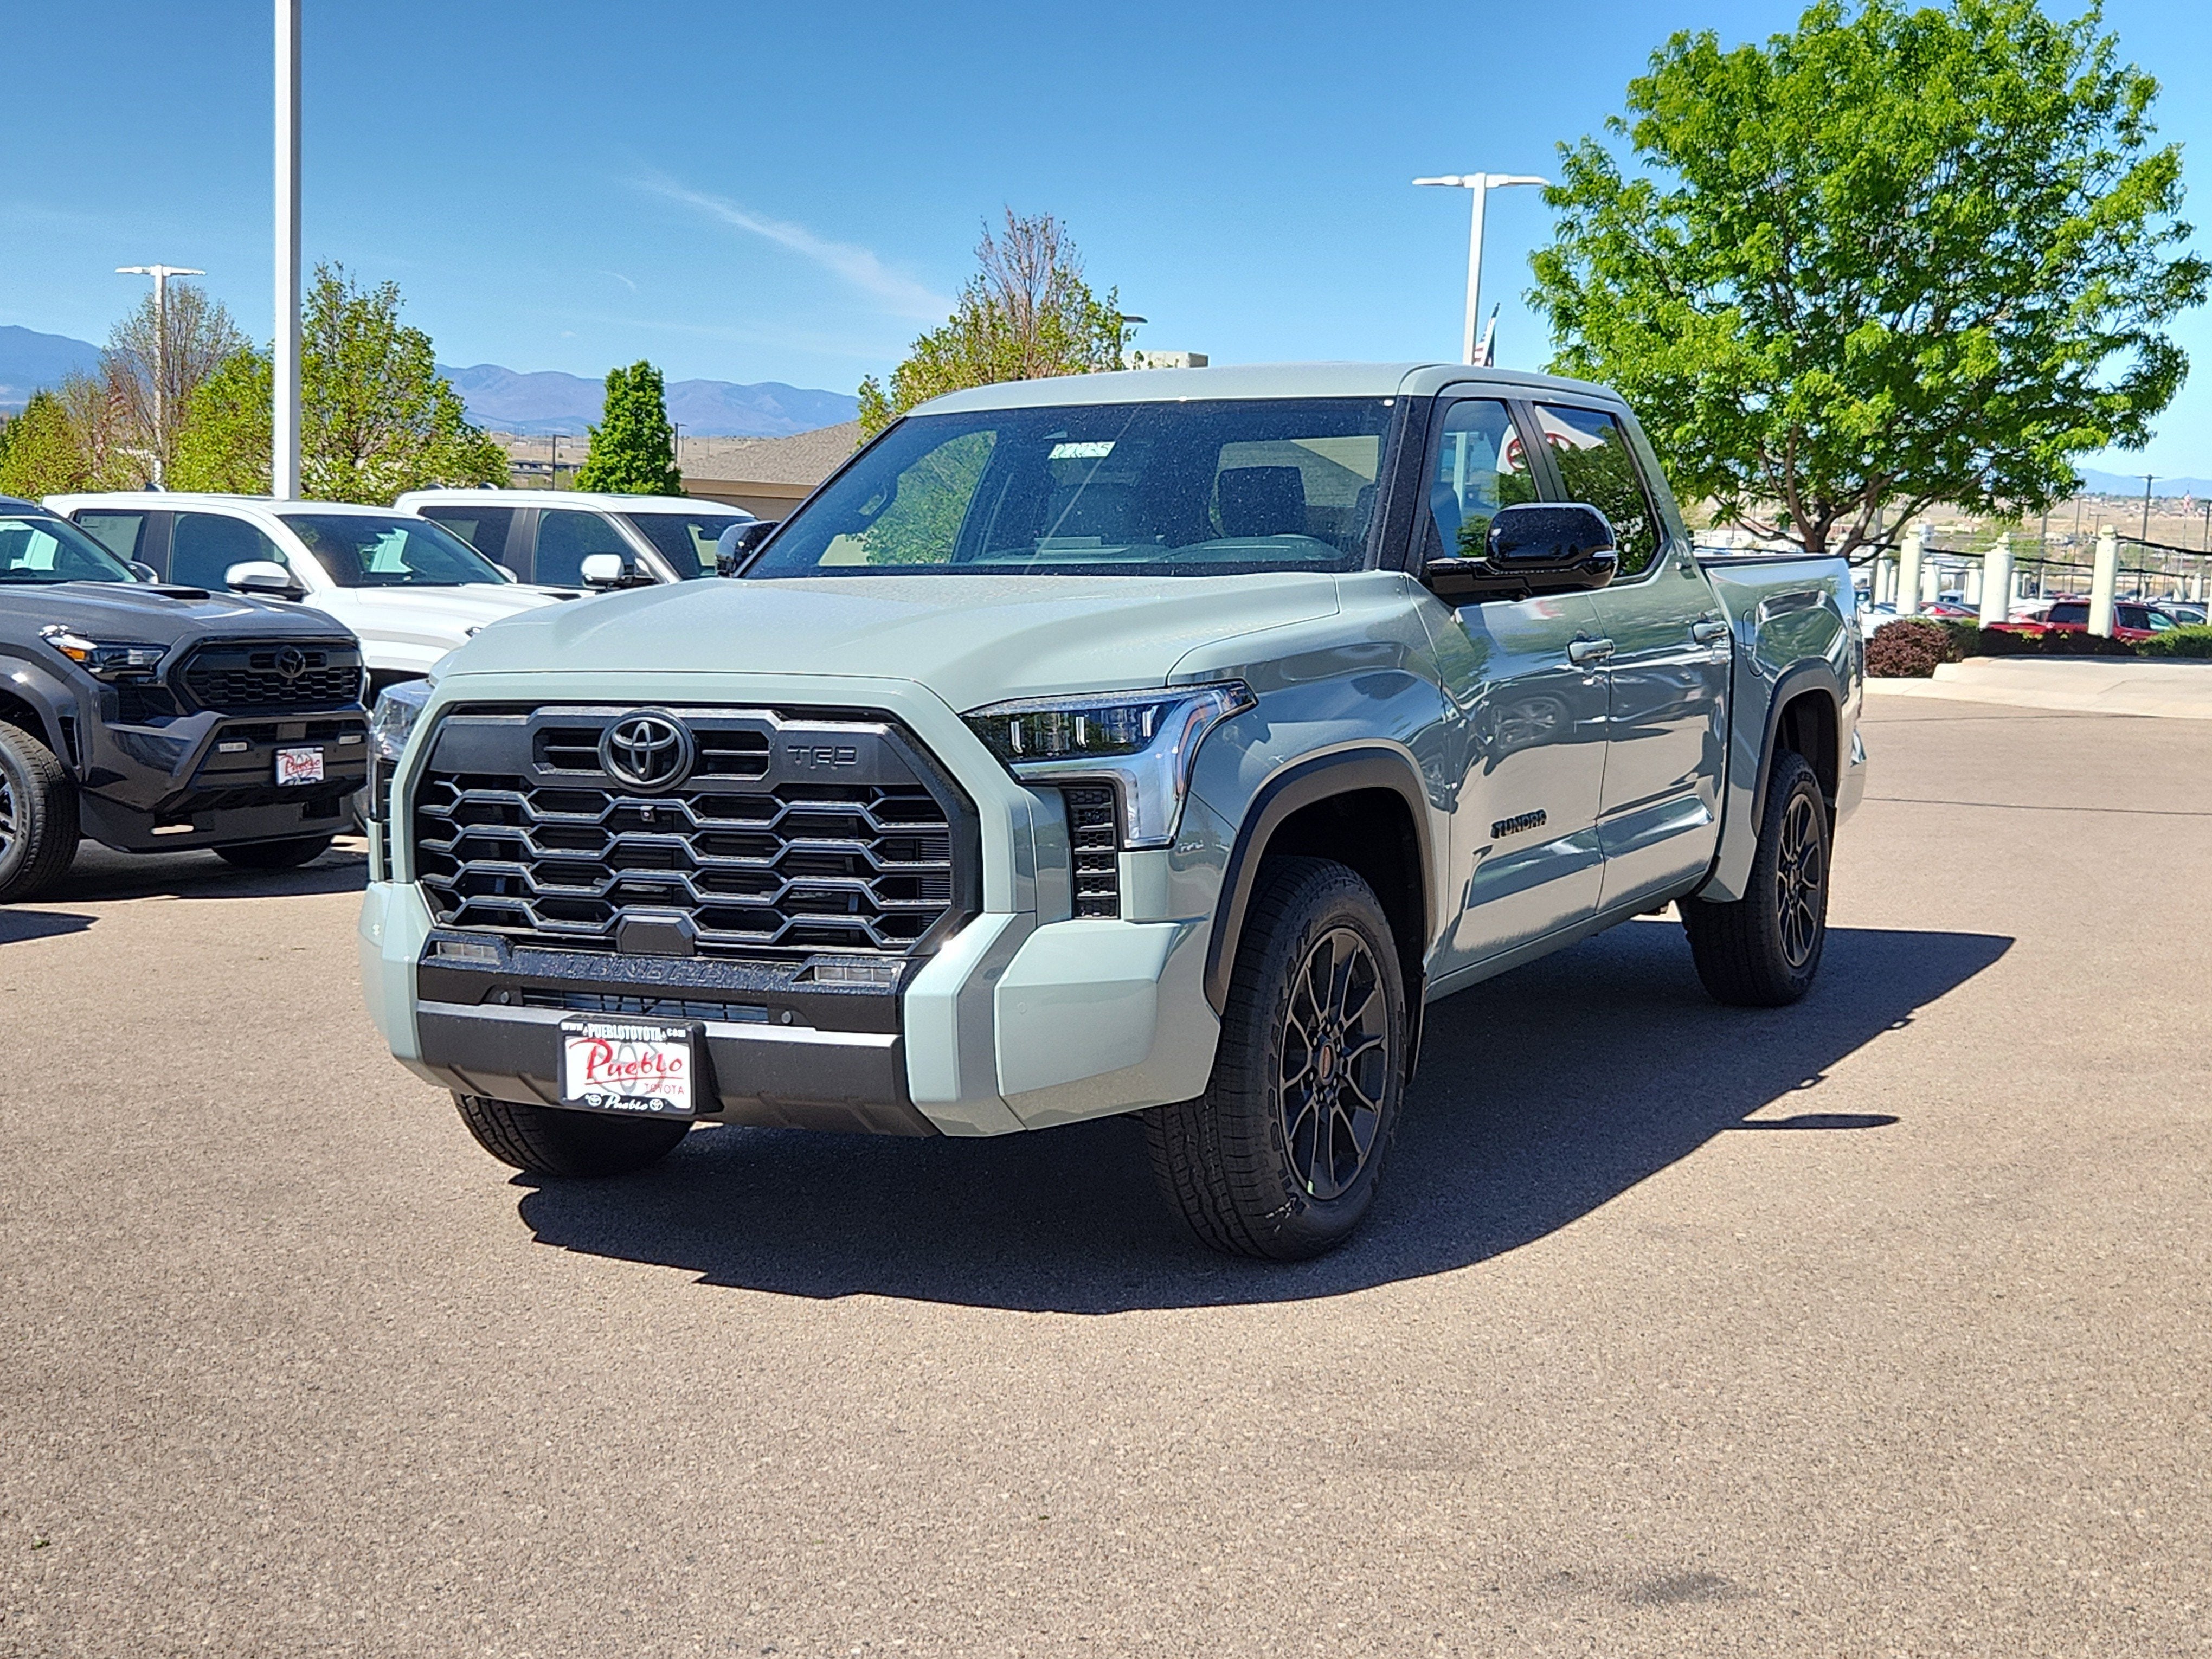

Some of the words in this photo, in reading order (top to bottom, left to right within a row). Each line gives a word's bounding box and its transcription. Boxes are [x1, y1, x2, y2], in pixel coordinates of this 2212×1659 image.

[787, 745, 858, 770] TRD
[1491, 809, 1547, 839] TUNDRA
[569, 1037, 683, 1080] Pueblo
[603, 1093, 648, 1110] Pueblo
[644, 1083, 685, 1095] TOYOTA
